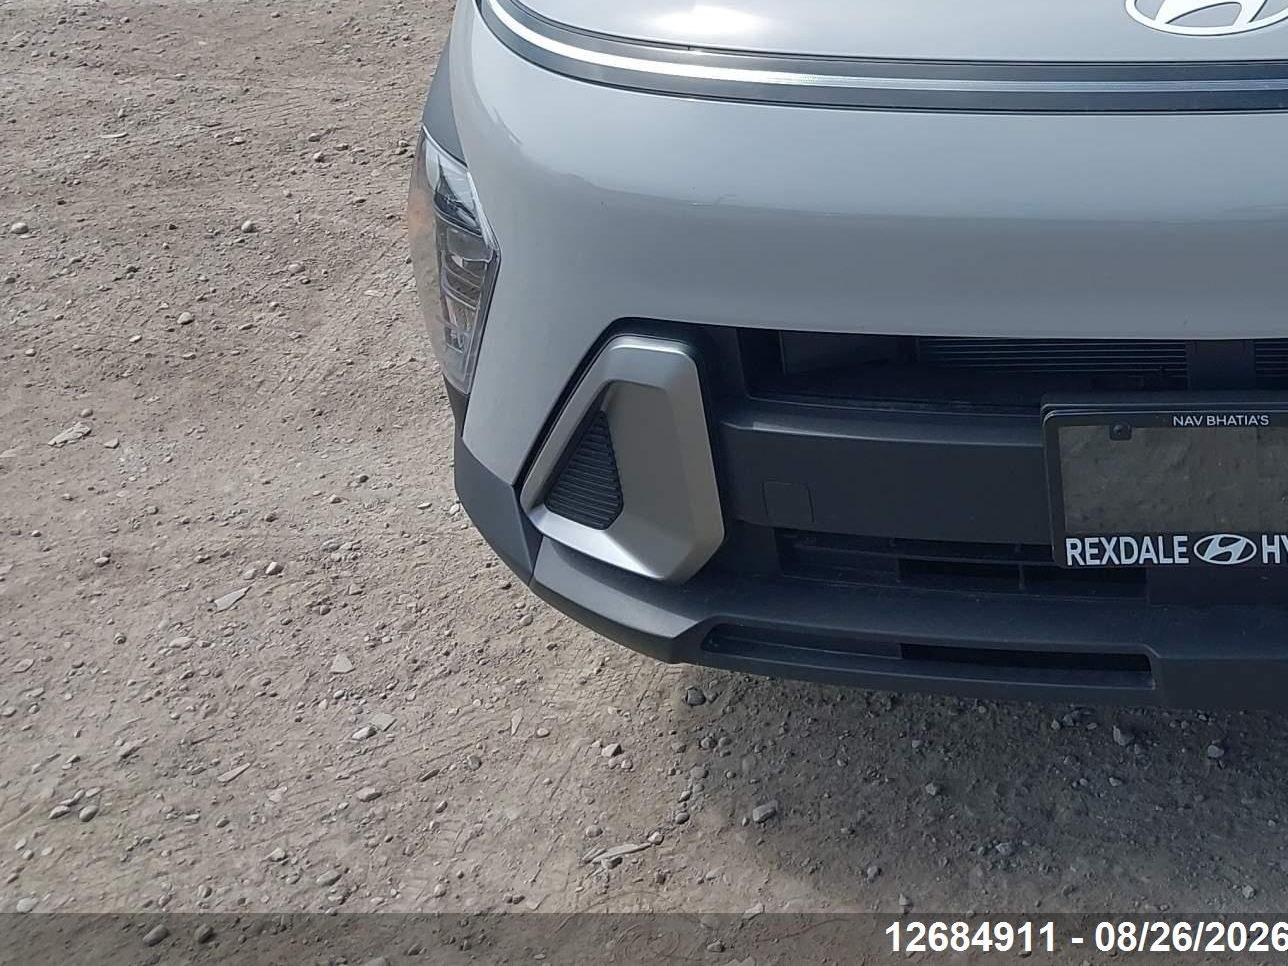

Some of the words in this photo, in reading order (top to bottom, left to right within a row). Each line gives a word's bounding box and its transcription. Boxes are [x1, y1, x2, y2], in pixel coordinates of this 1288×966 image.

[1172, 414, 1204, 427] NAV
[1206, 414, 1270, 427] BHATIA'S
[1064, 535, 1190, 567] REXDALE
